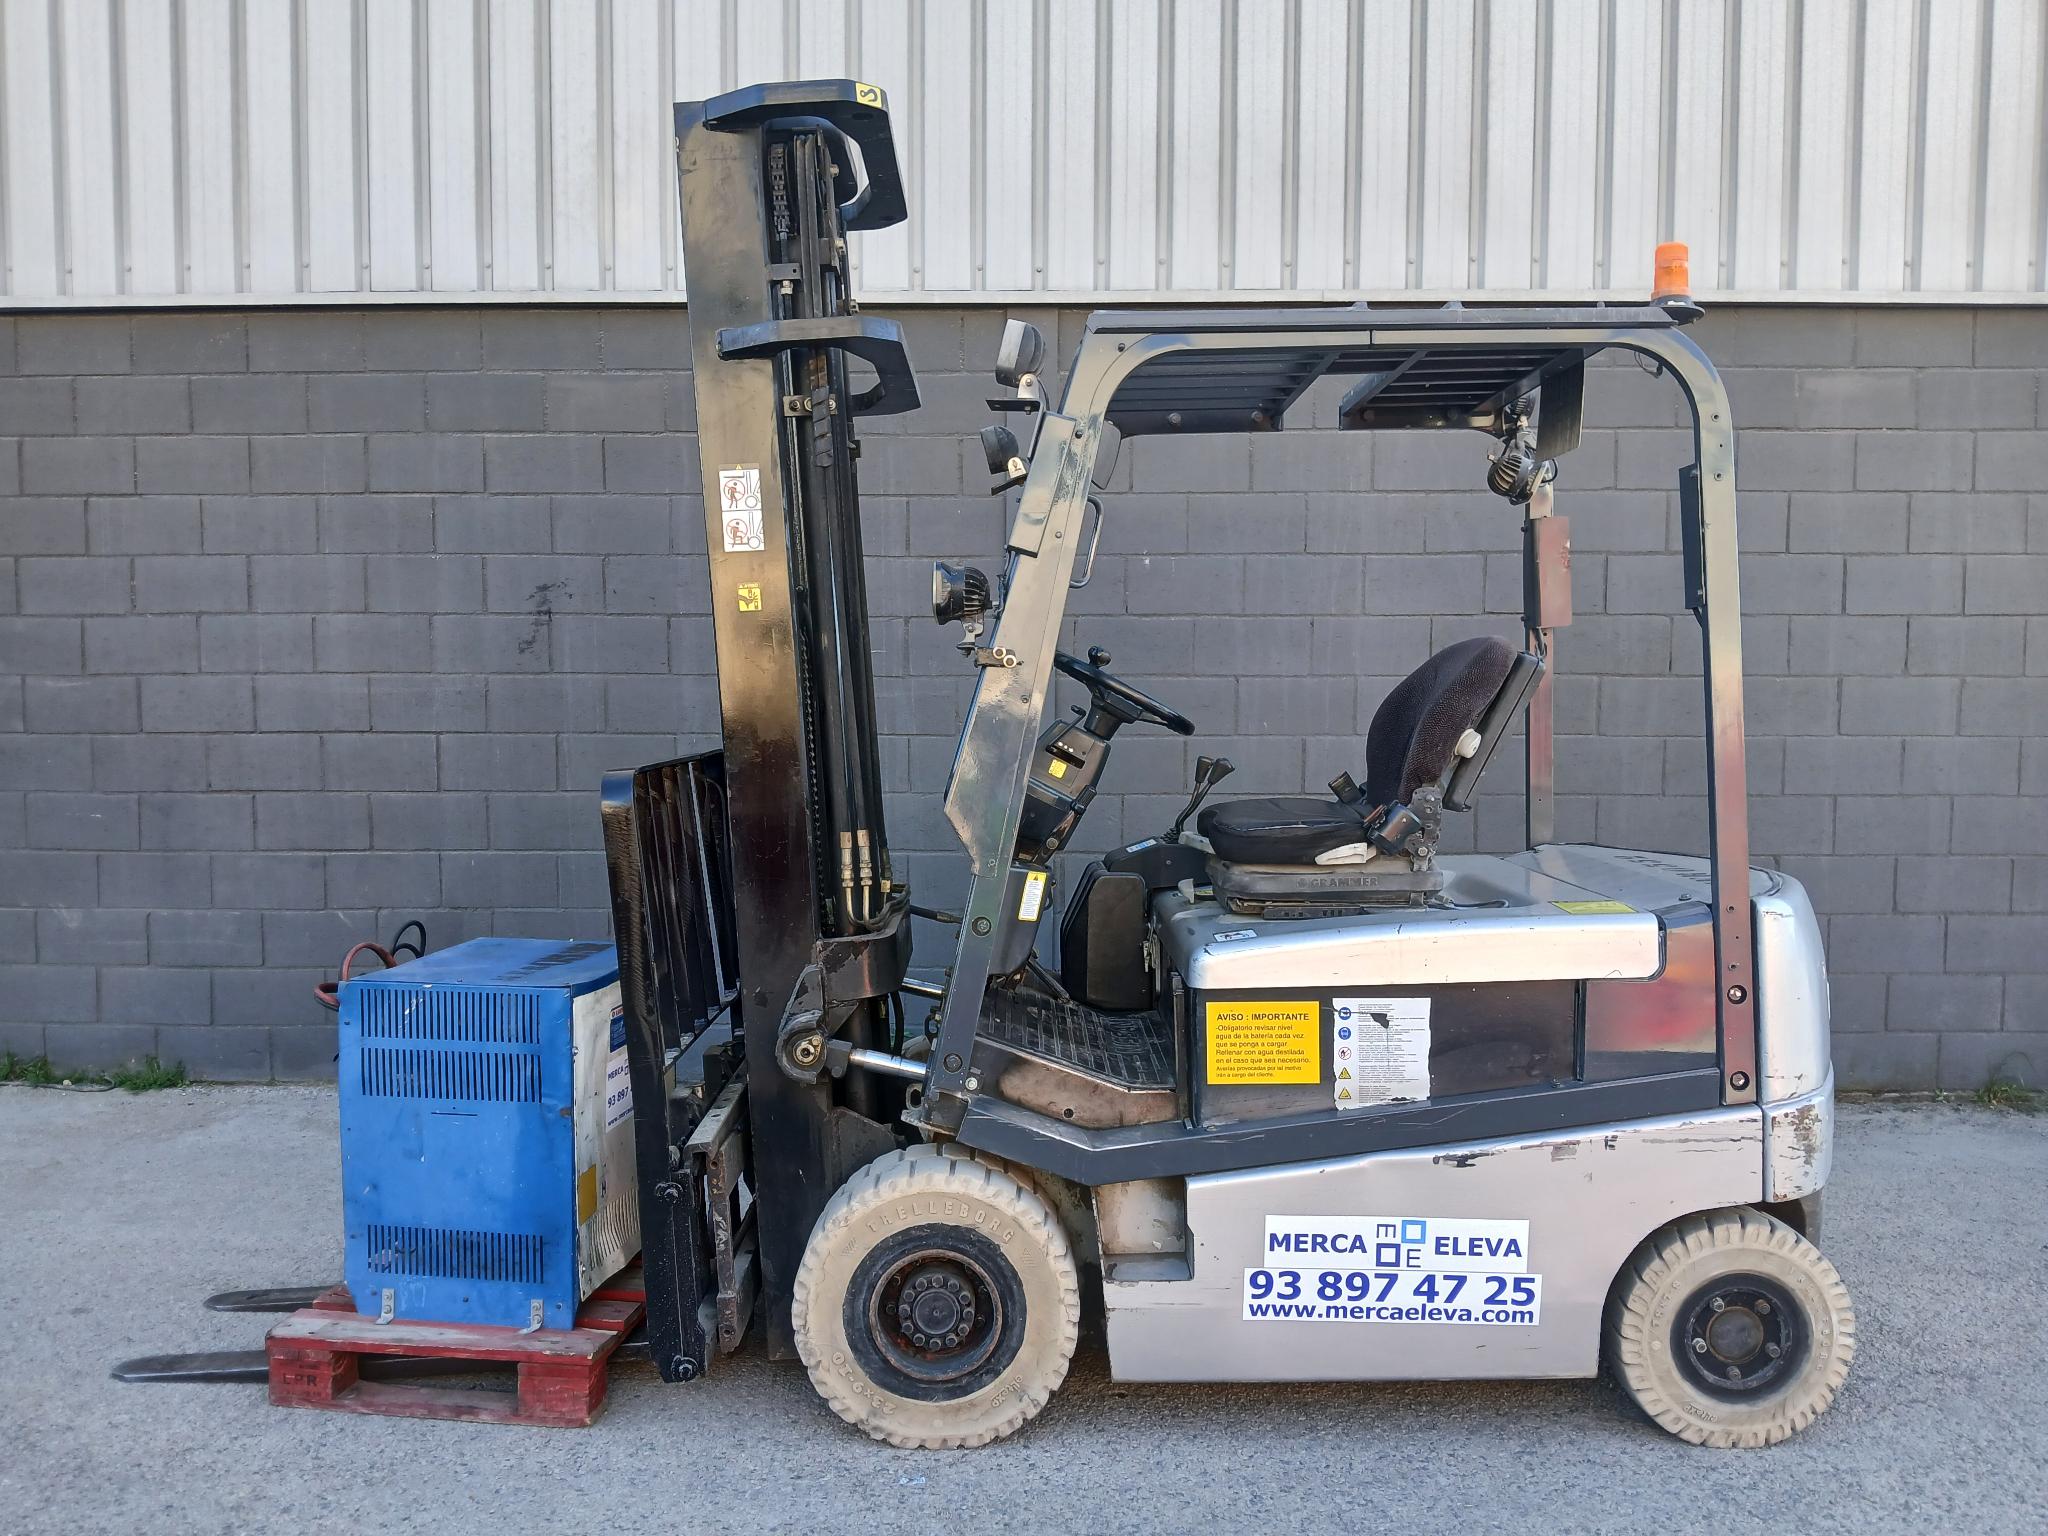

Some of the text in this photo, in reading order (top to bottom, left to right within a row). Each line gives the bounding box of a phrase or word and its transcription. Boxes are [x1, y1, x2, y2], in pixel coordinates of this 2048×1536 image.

[1310, 876, 1377, 888] GRAMMER
[1216, 1013, 1244, 1021] AVISO
[1251, 1013, 1310, 1021] IMPORTANTE
[1215, 1024, 1253, 1032] -Obligatorio
[607, 1094, 616, 1109] 93
[865, 1200, 1016, 1243] TRELLEBORG
[1269, 1232, 1368, 1254] MERCA
[1434, 1236, 1523, 1258] ELEVA
[1249, 1269, 1536, 1307] 93 897 47 25
[1248, 1303, 1534, 1324] www.mercaeleva.com
